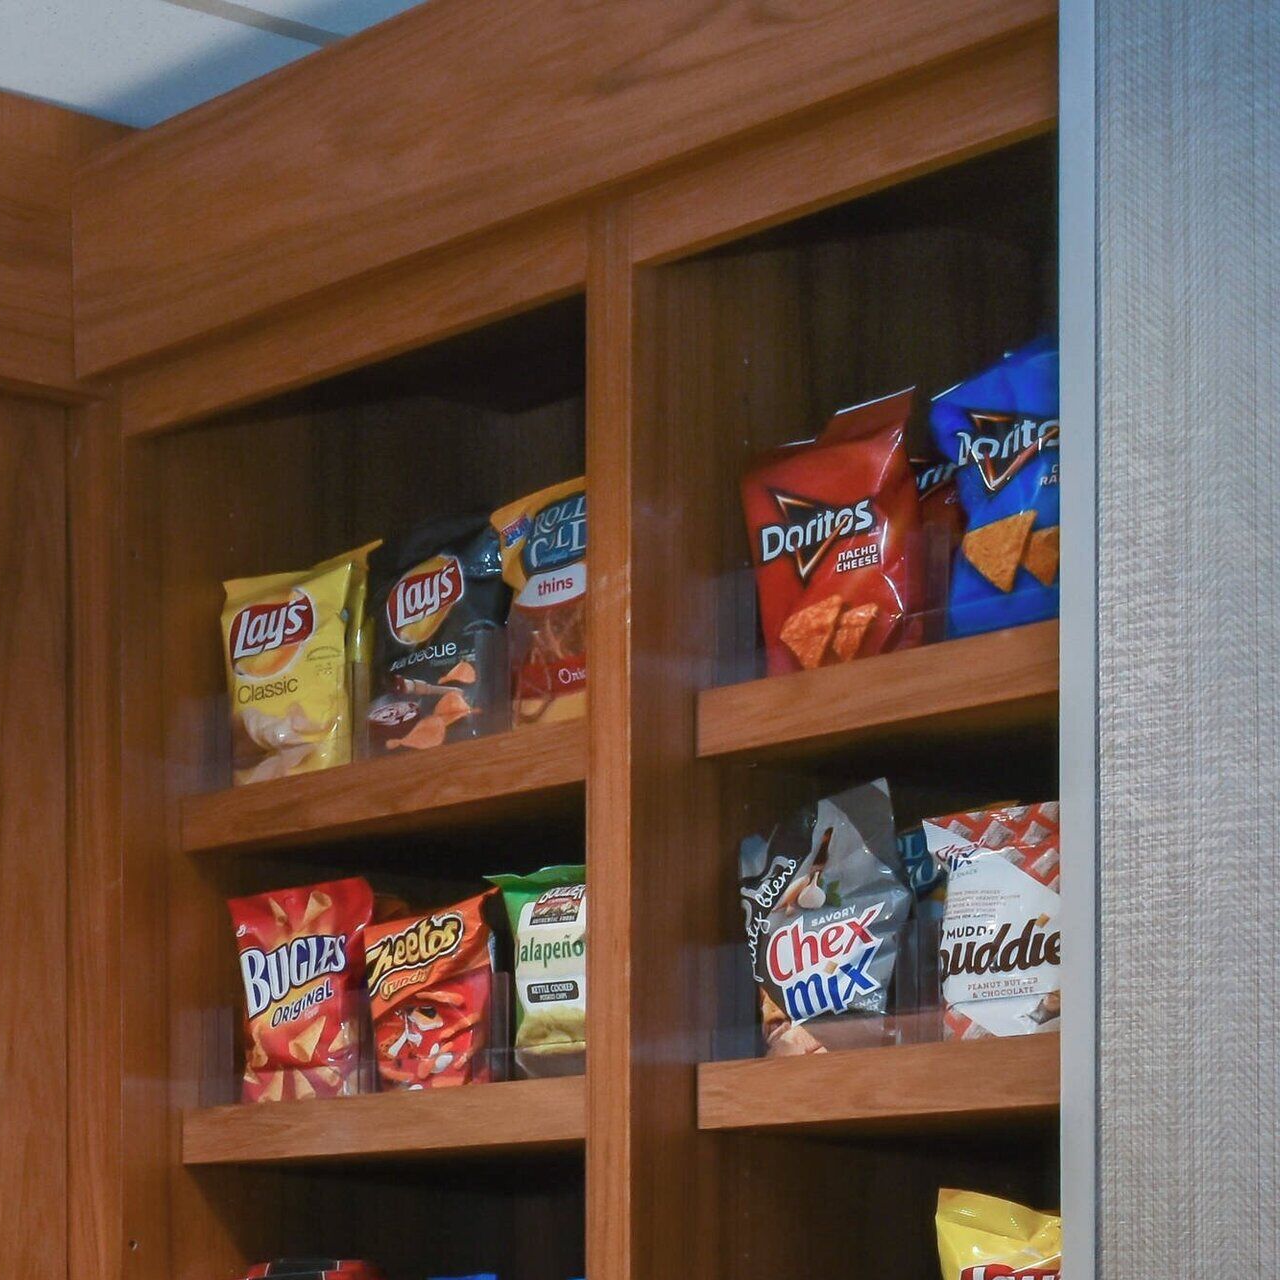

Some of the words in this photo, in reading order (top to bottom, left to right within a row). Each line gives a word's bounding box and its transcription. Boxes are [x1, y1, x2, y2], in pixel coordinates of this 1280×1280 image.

[957, 420, 1060, 467] Dorito
[761, 499, 875, 562] Doritos
[836, 553, 879, 573] CHEESE
[838, 544, 877, 562] NACHO
[396, 565, 456, 629] Lay's
[537, 577, 574, 596] thins
[233, 600, 309, 660] Lay's
[237, 676, 299, 705] Classic
[811, 905, 856, 927] SAVORY
[769, 907, 878, 983] Chex
[240, 935, 347, 1020] BUGLES
[967, 981, 1000, 991] PEANUT
[981, 986, 1035, 998] CHOCOLATE
